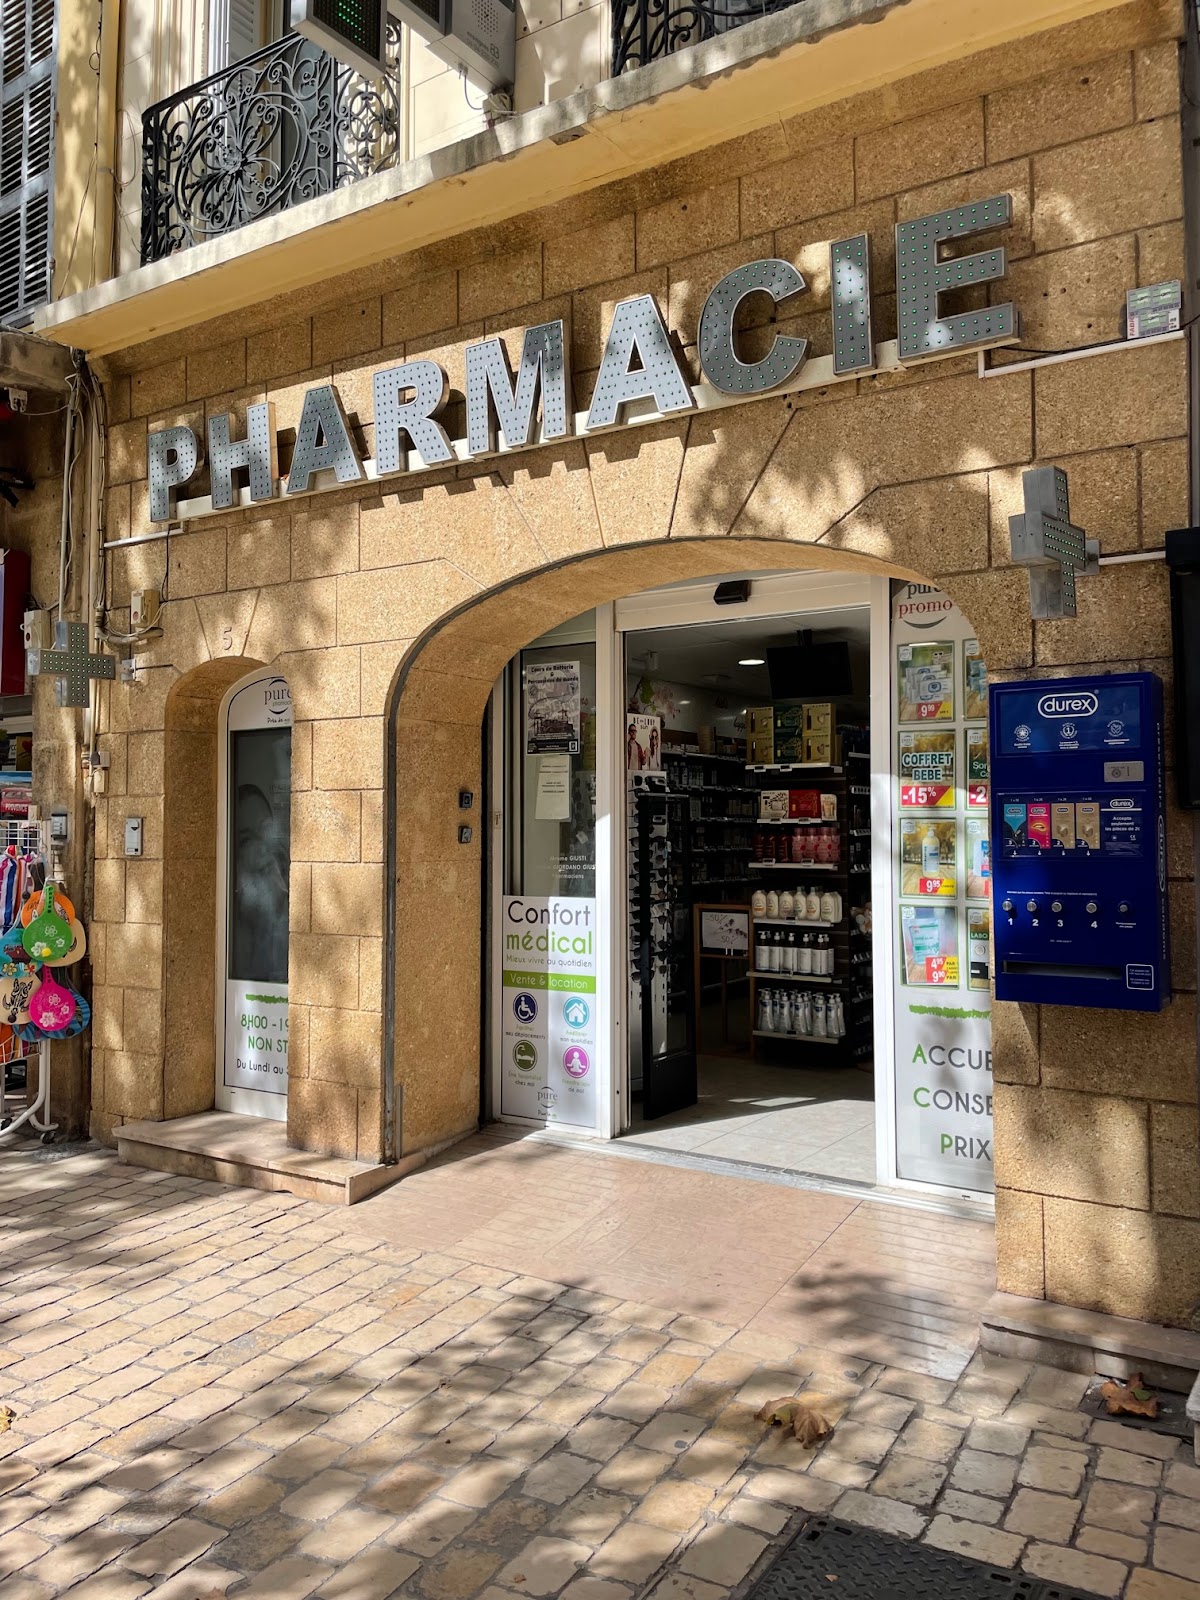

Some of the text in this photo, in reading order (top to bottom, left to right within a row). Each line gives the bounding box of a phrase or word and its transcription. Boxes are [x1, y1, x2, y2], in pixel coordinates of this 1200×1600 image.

[147, 193, 1020, 523] PHARMACIE
[898, 599, 953, 619] promo
[222, 626, 233, 651] 5
[1043, 698, 1093, 713] durex
[903, 753, 952, 766] COFFRET
[913, 769, 941, 781] BEBE
[902, 786, 937, 804] -15%
[507, 900, 591, 926] Confort
[1032, 918, 1039, 926] 2
[1057, 919, 1064, 927] 3
[1090, 920, 1098, 928] 4
[506, 928, 592, 955] médical
[506, 954, 526, 963] Mieux
[528, 956, 544, 964] vivre
[557, 959, 592, 968] quotidien
[510, 973, 588, 989] Vente & location
[240, 1014, 268, 1030] 8H00
[248, 1036, 272, 1052] NON
[570, 1037, 594, 1046] quotidien
[236, 1058, 246, 1069] Du
[249, 1060, 270, 1073] Lundi
[273, 1066, 284, 1075] au
[537, 1090, 558, 1101] pure
[913, 1087, 993, 1117] CONSE
[940, 1133, 991, 1161] PRIX
